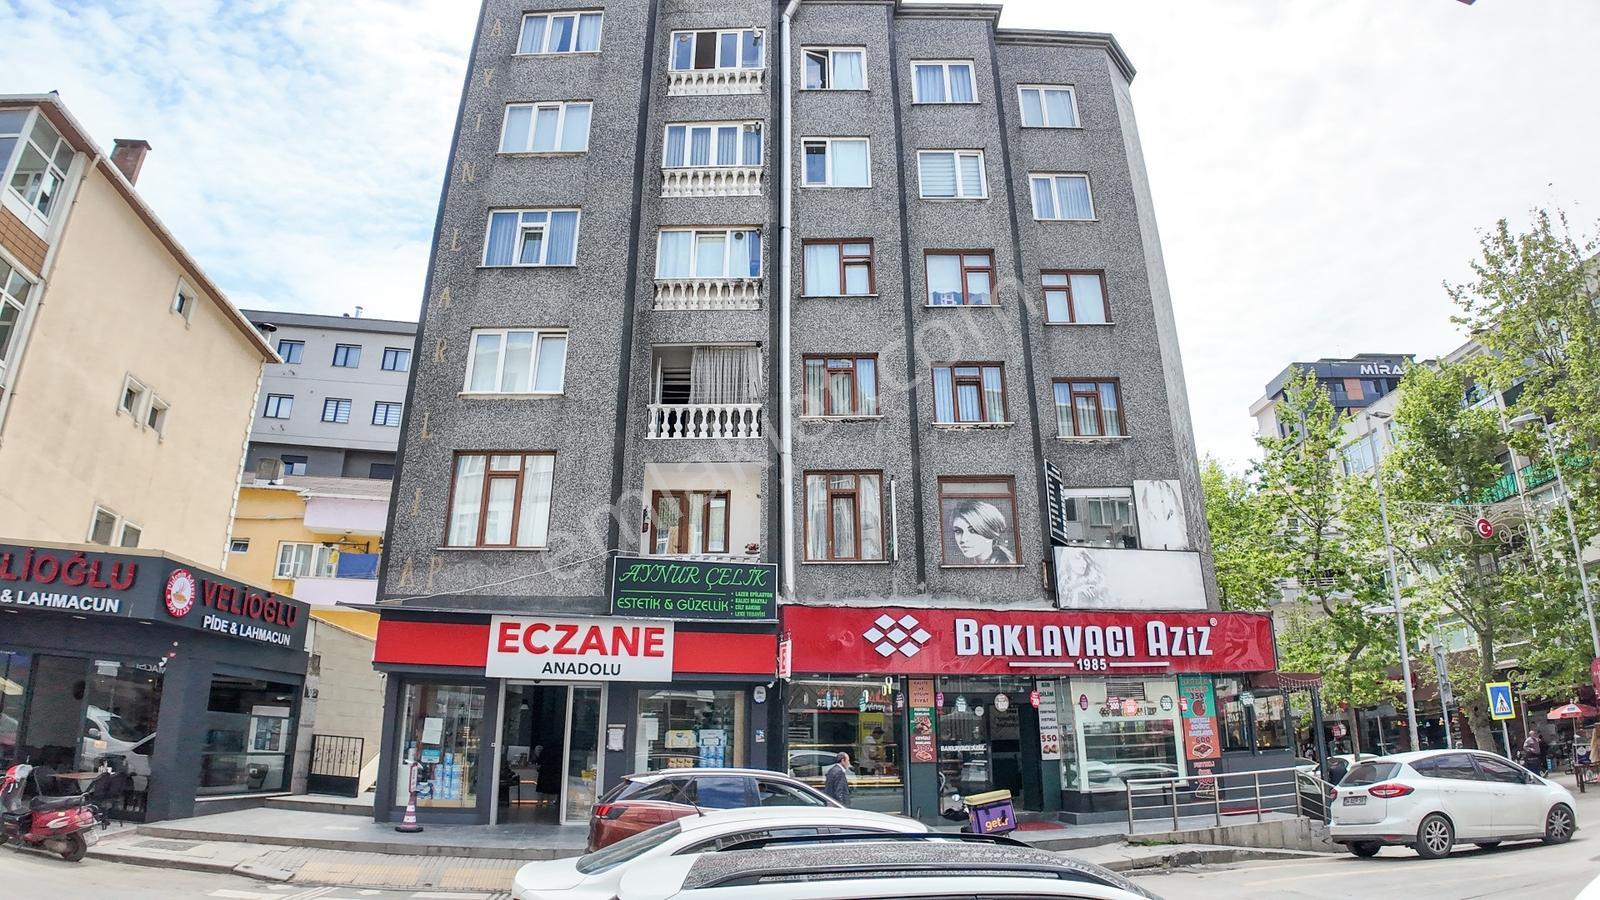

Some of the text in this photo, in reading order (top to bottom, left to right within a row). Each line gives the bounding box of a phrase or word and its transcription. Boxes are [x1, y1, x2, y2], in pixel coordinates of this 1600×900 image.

[619, 564, 771, 591] AYNUR ÇELİK
[1, 589, 120, 613] & LAHMACUN
[203, 579, 299, 628] VELİOĞLU
[617, 595, 729, 612] ESTETİK & GÜZELLİK
[203, 614, 291, 647] PİDE & LAHMACUN
[497, 622, 665, 658] ECZANE
[955, 618, 1136, 657] BAKLAVACI
[541, 661, 622, 676] ANADOLU
[1076, 658, 1107, 671] 1985
[1041, 734, 1057, 743] 550
